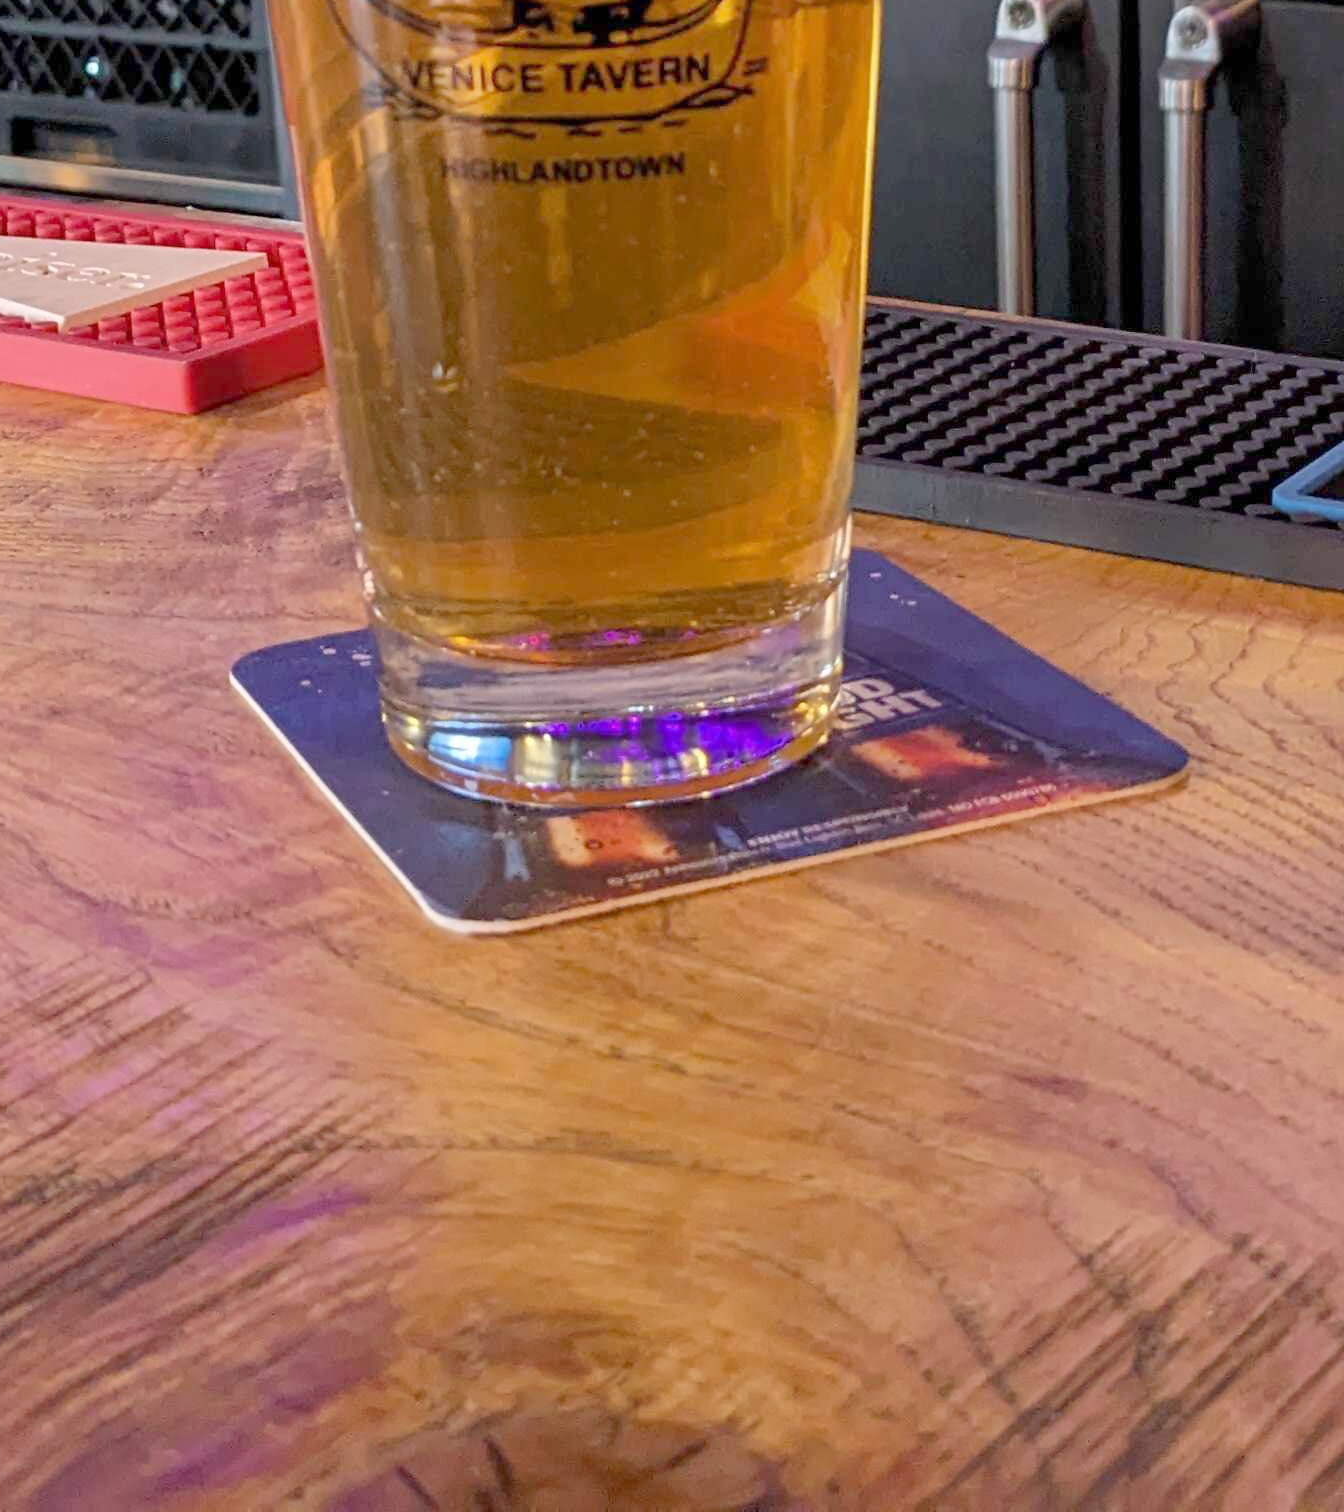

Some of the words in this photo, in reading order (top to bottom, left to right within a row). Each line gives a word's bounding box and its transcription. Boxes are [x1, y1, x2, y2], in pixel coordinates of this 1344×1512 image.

[401, 61, 545, 92] VENICE
[559, 54, 709, 93] TAVERN
[439, 151, 687, 185] HIGHLANDTOWN
